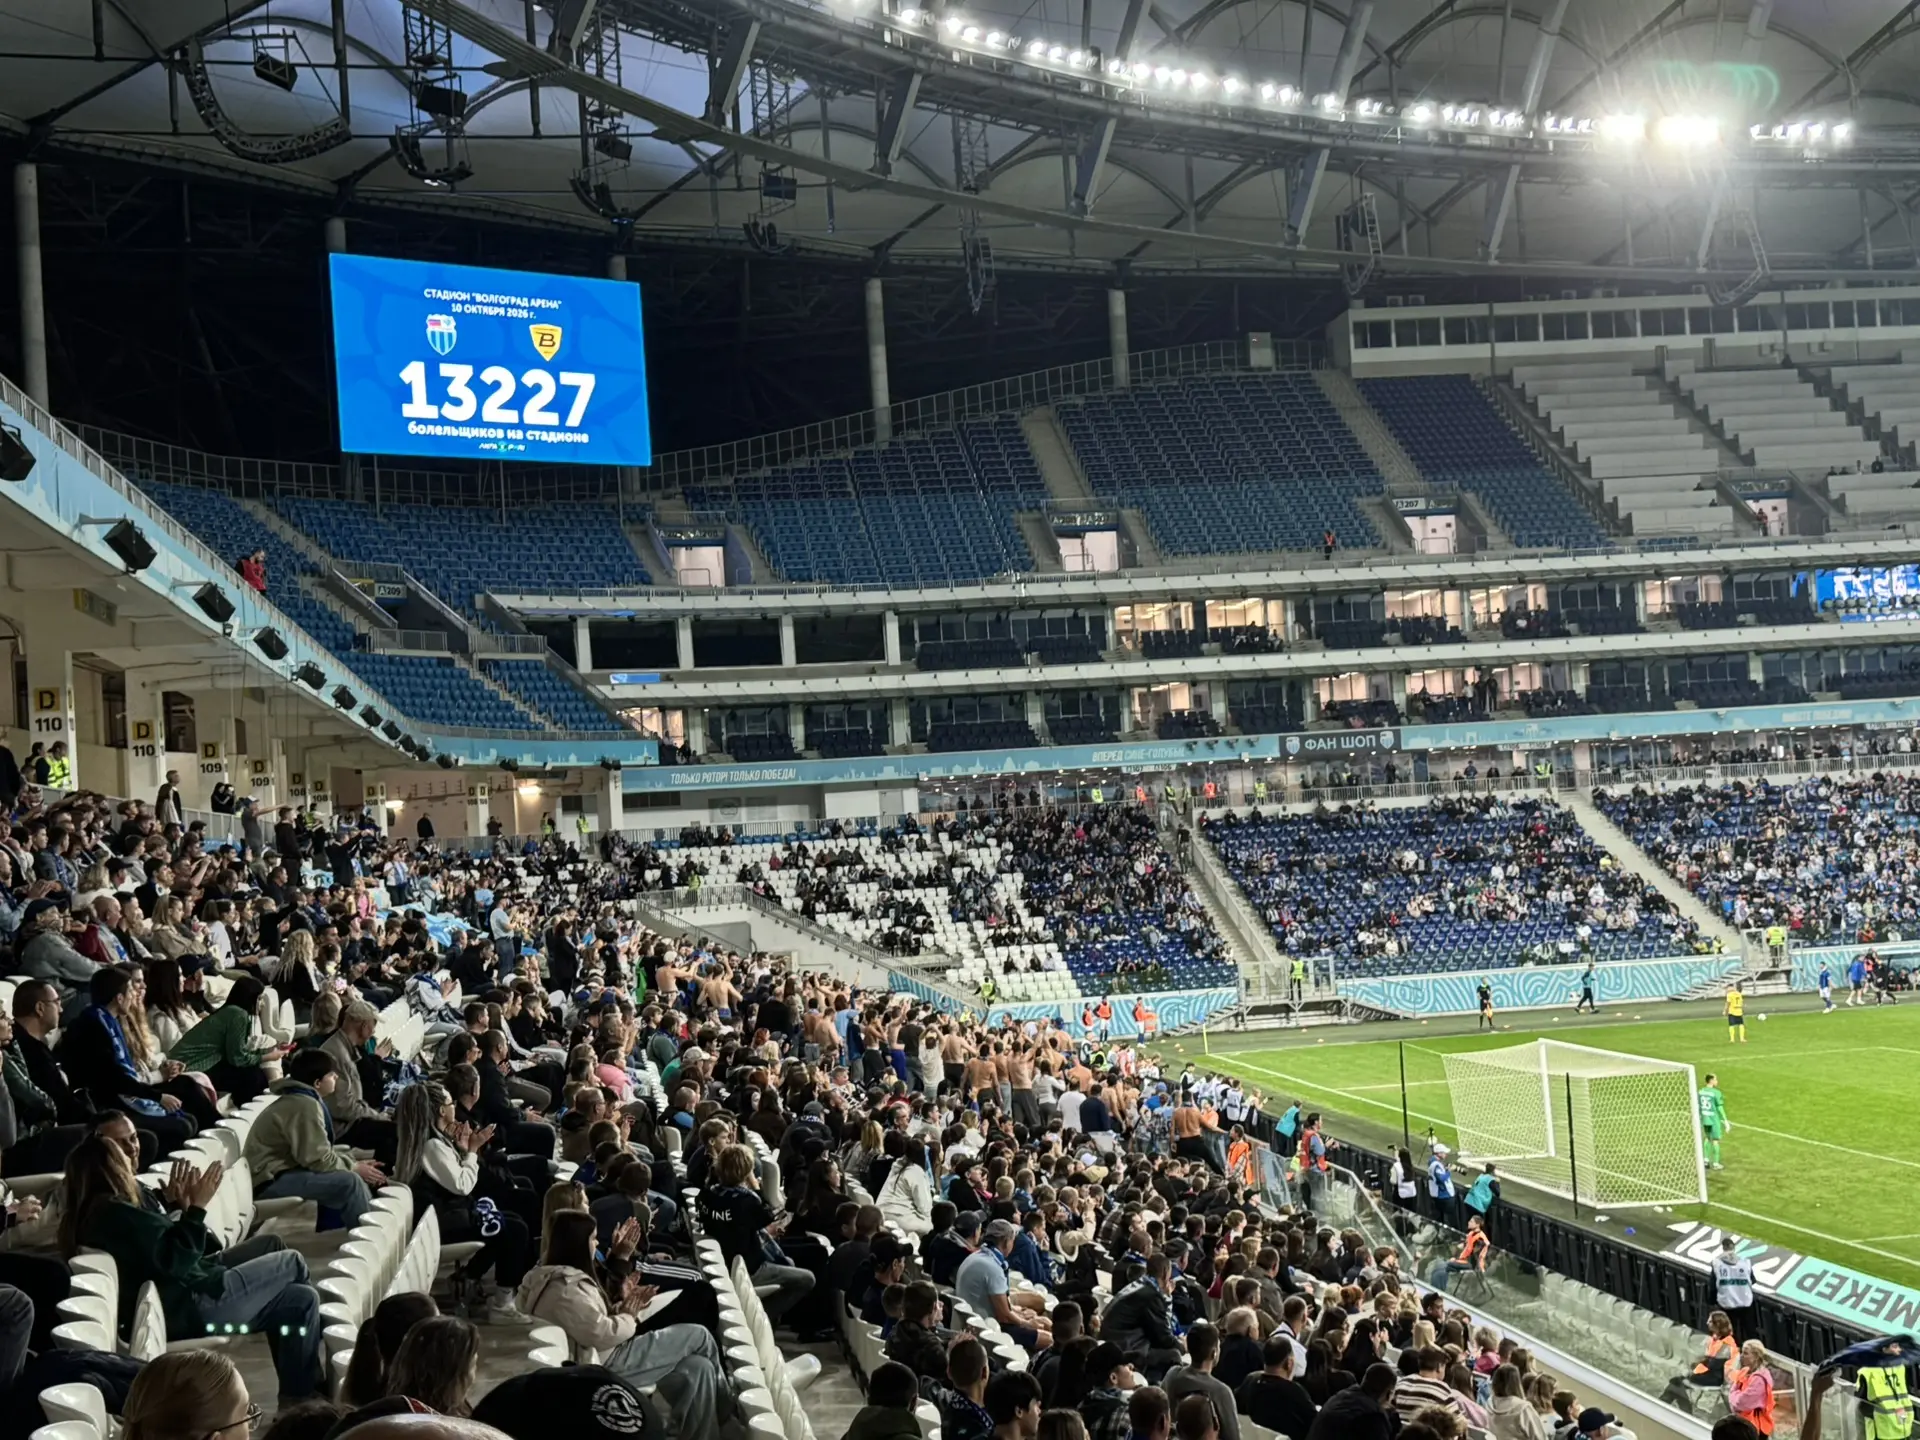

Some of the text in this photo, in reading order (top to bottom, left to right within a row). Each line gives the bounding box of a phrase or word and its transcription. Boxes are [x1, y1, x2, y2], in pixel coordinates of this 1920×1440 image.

[424, 288, 471, 301] СТАДИОН
[451, 303, 462, 313] 10
[464, 304, 505, 317] ОКТЯБРЯ
[399, 360, 596, 428] 13227
[407, 421, 590, 444] болельщиков на стадионе
[39, 690, 55, 710] D
[35, 717, 62, 732] 110
[136, 722, 150, 740] D
[1304, 735, 1376, 751] ФАН ШОП
[132, 744, 155, 757] 110
[204, 743, 215, 758] D
[200, 763, 222, 774] 109
[254, 760, 265, 773] D
[251, 777, 270, 787] 109
[293, 773, 302, 784] D
[671, 768, 796, 785] ТОЛЬКО РОТОР! ТОЛЬКО ПОБЕДА!
[290, 788, 306, 797] 108
[315, 781, 323, 791] D
